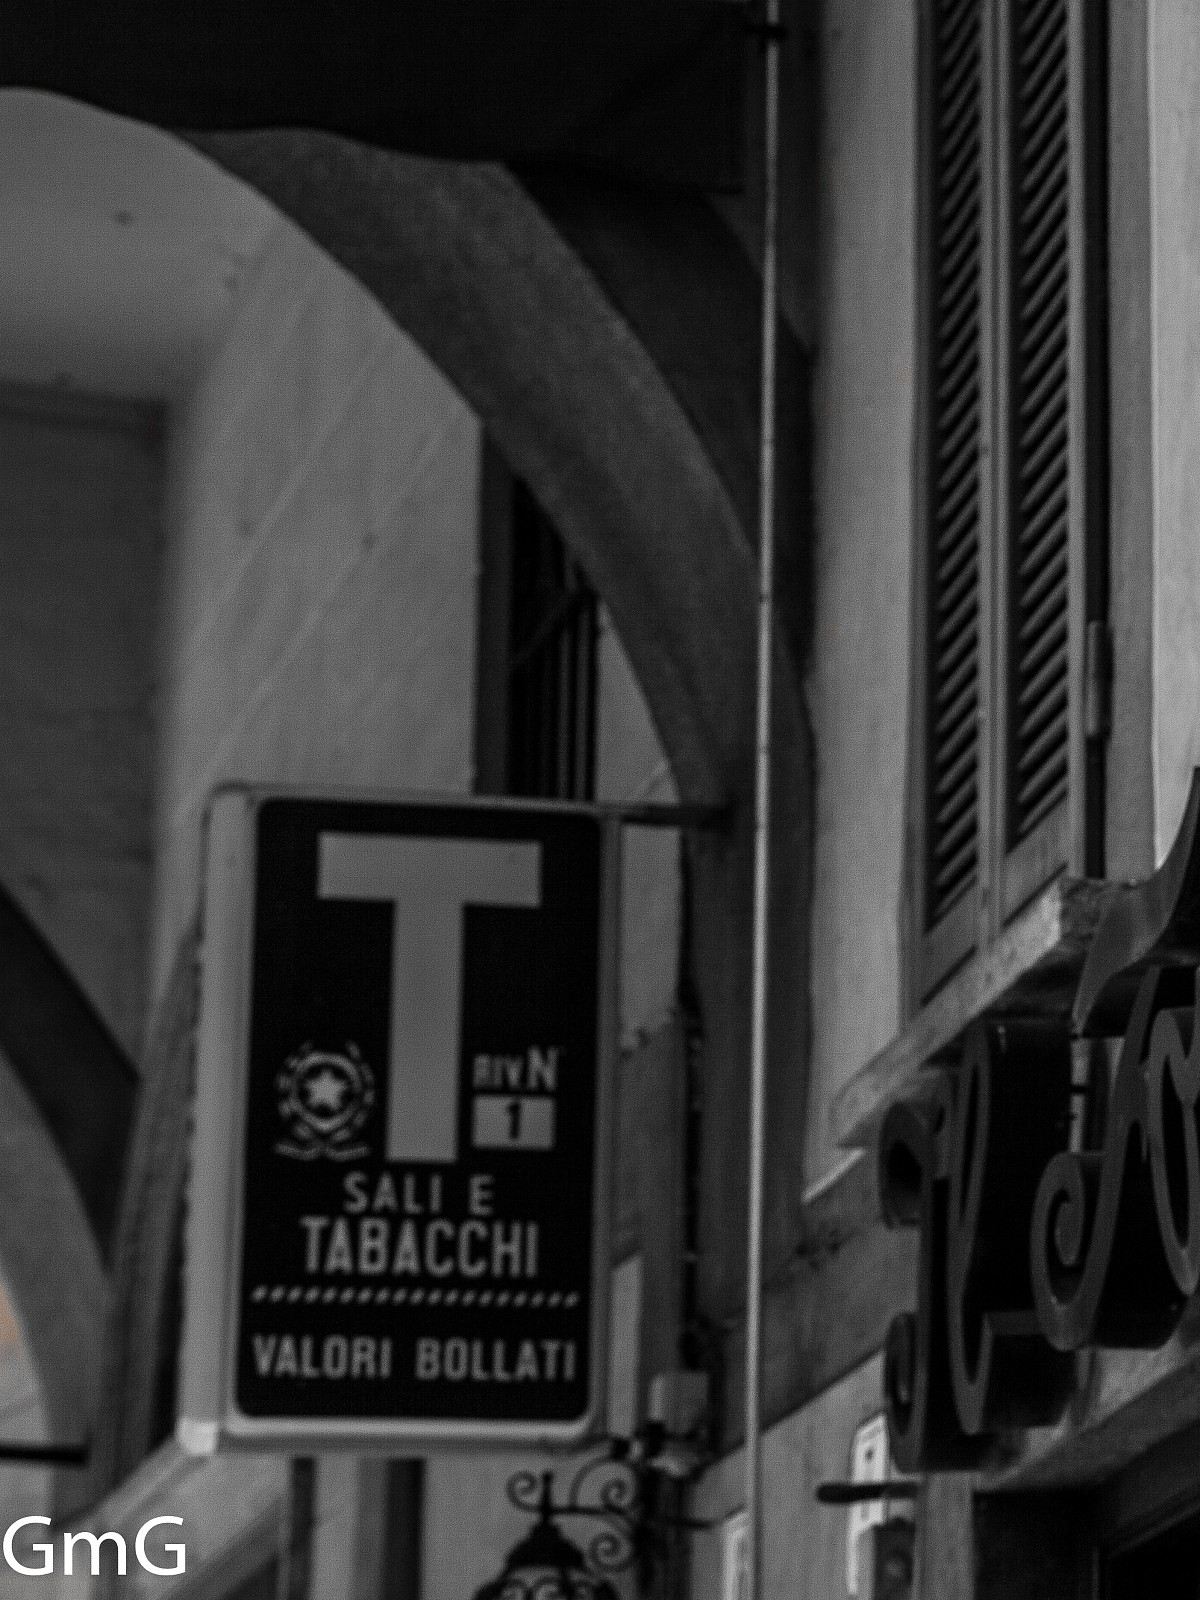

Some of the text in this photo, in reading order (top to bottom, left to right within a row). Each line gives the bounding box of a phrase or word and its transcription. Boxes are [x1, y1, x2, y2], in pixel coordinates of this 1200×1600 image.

[316, 830, 543, 1163] T
[503, 1102, 522, 1141] 1
[342, 1171, 496, 1217] SALI E
[300, 1215, 539, 1279] TABACCHI
[252, 1334, 577, 1383] VALORI BOLLATI
